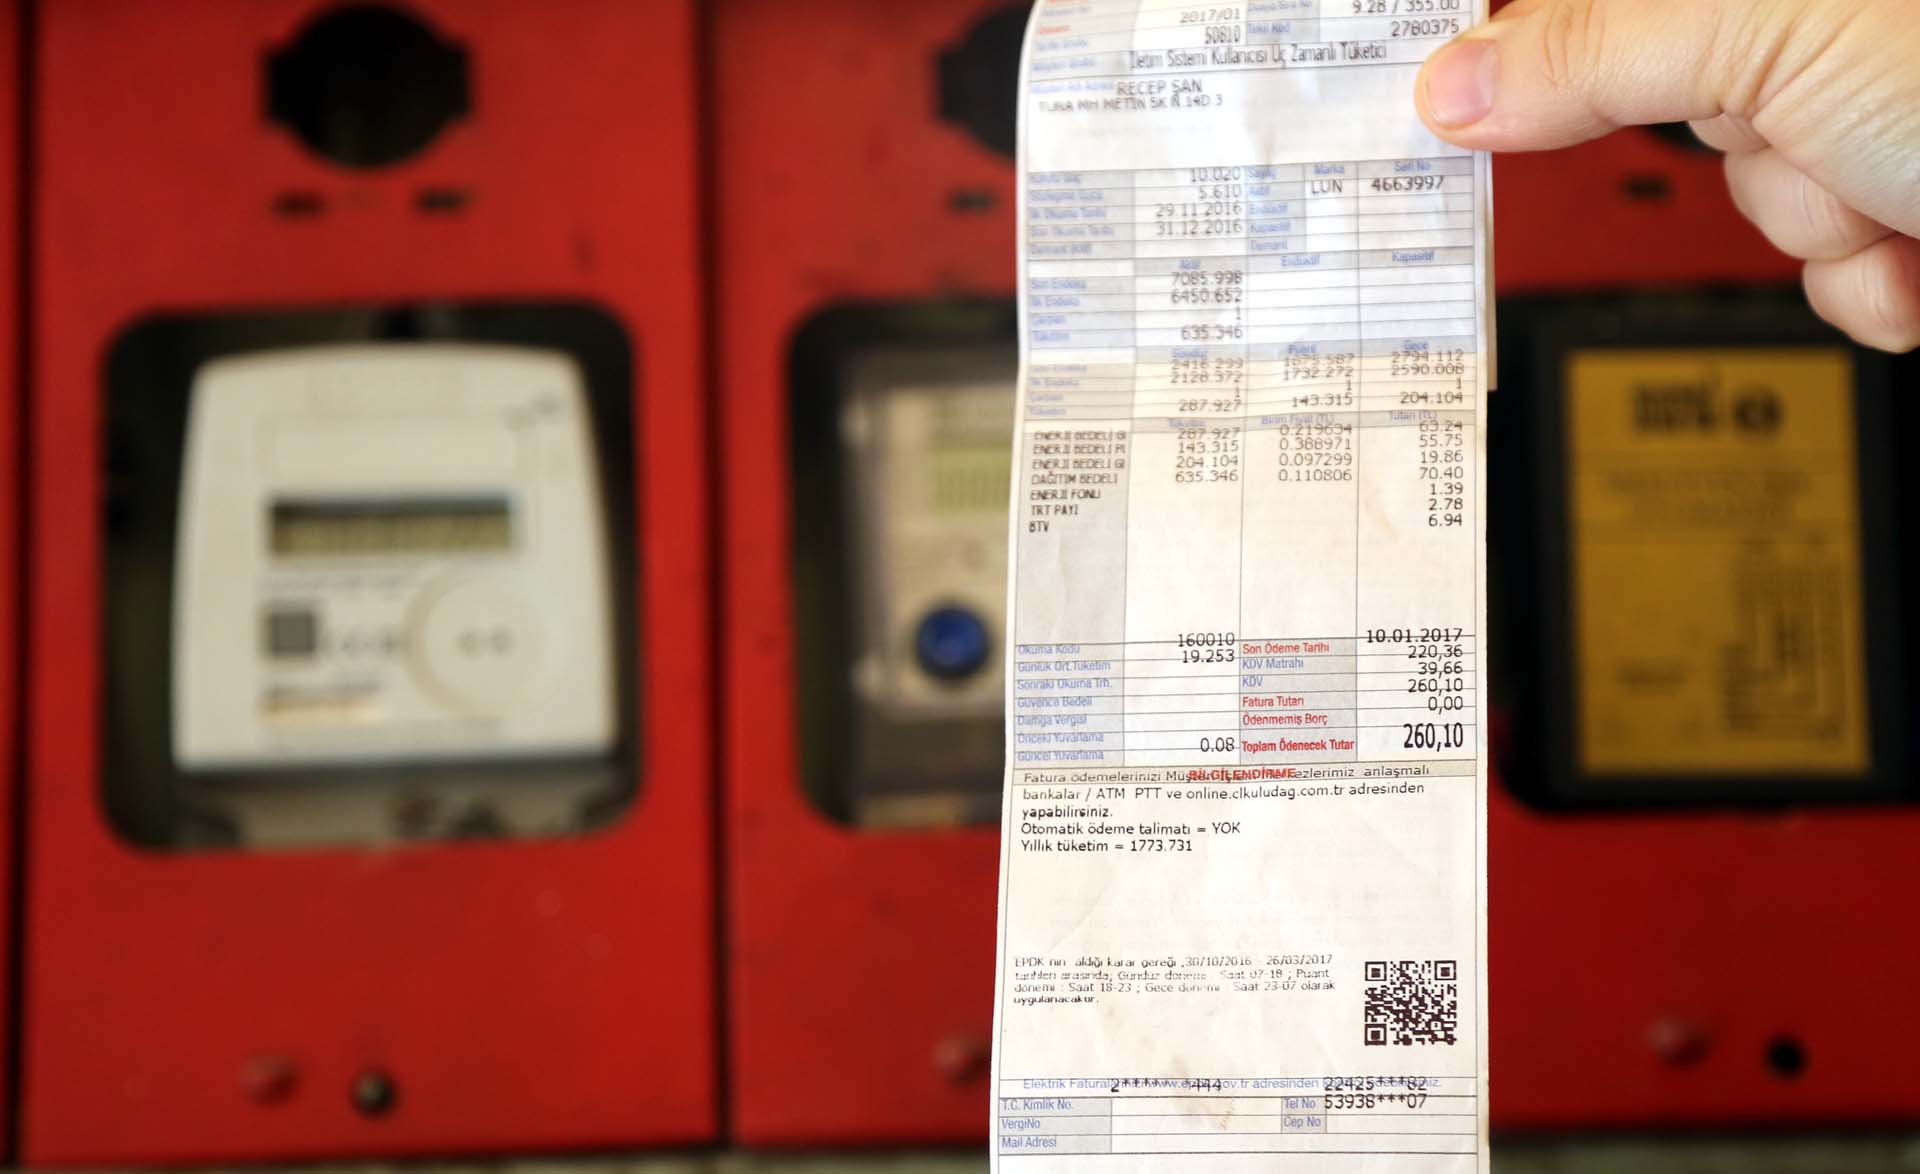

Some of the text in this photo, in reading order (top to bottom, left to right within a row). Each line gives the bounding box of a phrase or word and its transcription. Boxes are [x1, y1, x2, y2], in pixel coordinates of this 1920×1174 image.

[1180, 8, 1240, 23] 2017/01
[1391, 19, 1459, 37] 2780375
[1205, 26, 1240, 44] 50810
[1118, 81, 1166, 96] RECEP
[1191, 167, 1240, 182] 10.020
[1312, 180, 1342, 194] LUN
[1371, 176, 1444, 191] 4663997
[1199, 185, 1241, 200] 5.610
[1156, 202, 1242, 217] 29.11.2016
[1157, 220, 1242, 236] 31.12.2016
[1172, 271, 1242, 286] 7085.998
[1171, 288, 1242, 303] 6450.652
[1181, 324, 1243, 341] 635.346
[1283, 367, 1354, 380] 1732.272
[1392, 364, 1464, 376] 2590.008
[1346, 380, 1352, 391] 1
[1456, 378, 1462, 389] 1
[1292, 393, 1353, 407] 143.315
[1400, 391, 1463, 404] 204.104
[1178, 400, 1242, 412] 287.927
[1419, 420, 1463, 432] 63.24
[1178, 427, 1240, 440] 287.927
[1178, 441, 1239, 454] 143.315
[1279, 437, 1351, 451] 0.388971
[1419, 434, 1463, 448] 55.75
[1176, 456, 1238, 469] 204.104
[1279, 452, 1352, 467] 0.097299
[1420, 450, 1463, 464] 19.86
[1176, 470, 1238, 483] 635.346
[1278, 469, 1352, 482] 0.110806
[1419, 466, 1463, 480] 70.40
[1071, 489, 1101, 499] FONU
[1430, 483, 1463, 496] 1.39
[1031, 506, 1051, 516] TRT
[1429, 498, 1463, 511] 2.78
[1429, 514, 1463, 527] 6.94
[1178, 633, 1235, 648] 160010
[1367, 629, 1462, 643] 10.01.2017
[1243, 644, 1263, 655] Son
[1408, 645, 1463, 661] 220,36
[1182, 649, 1235, 664] 19.253
[1243, 660, 1263, 669] KDV
[1419, 661, 1463, 677] 39,66
[1243, 677, 1263, 687] KDV
[1408, 678, 1463, 695] 260,10
[1243, 696, 1274, 707] Fatura
[1428, 696, 1463, 714] 0,00
[1243, 713, 1328, 725] Ödenmemiş Borç
[1403, 723, 1463, 751] 260,10
[1201, 737, 1235, 752] 0.08
[1243, 739, 1354, 754] Toplam Ödenecek Tutar
[1025, 773, 1066, 783] Fatura
[1364, 765, 1429, 779] anlaşmalı
[1024, 784, 1424, 800] bankalar ATM PTT ve online.clkuludag.com.tr adresinden
[1023, 806, 1113, 819] yapabilirsiniz.
[1021, 822, 1241, 834] Otomatik ödeme talimatı YOK
[1057, 840, 1108, 851] tüketim
[1131, 840, 1192, 851] 1773.731
[1015, 957, 1044, 967] EPDK
[1267, 954, 1332, 965] 26/03/2017
[1297, 969, 1329, 978] Puant
[1069, 983, 1094, 992] Saat
[1100, 983, 1131, 992] 18-23
[1145, 982, 1173, 992] Gece
[1234, 981, 1259, 991] Saat
[1264, 981, 1297, 990] 23-07
[1252, 1079, 1318, 1088] adresinden
[1024, 1099, 1054, 1110] Kimlik
[1285, 1098, 1315, 1108] Tel No
[1002, 1119, 1040, 1131] VergiNo
[1284, 1116, 1321, 1129] Cep No
[1002, 1137, 1057, 1147] Mail Adresi
